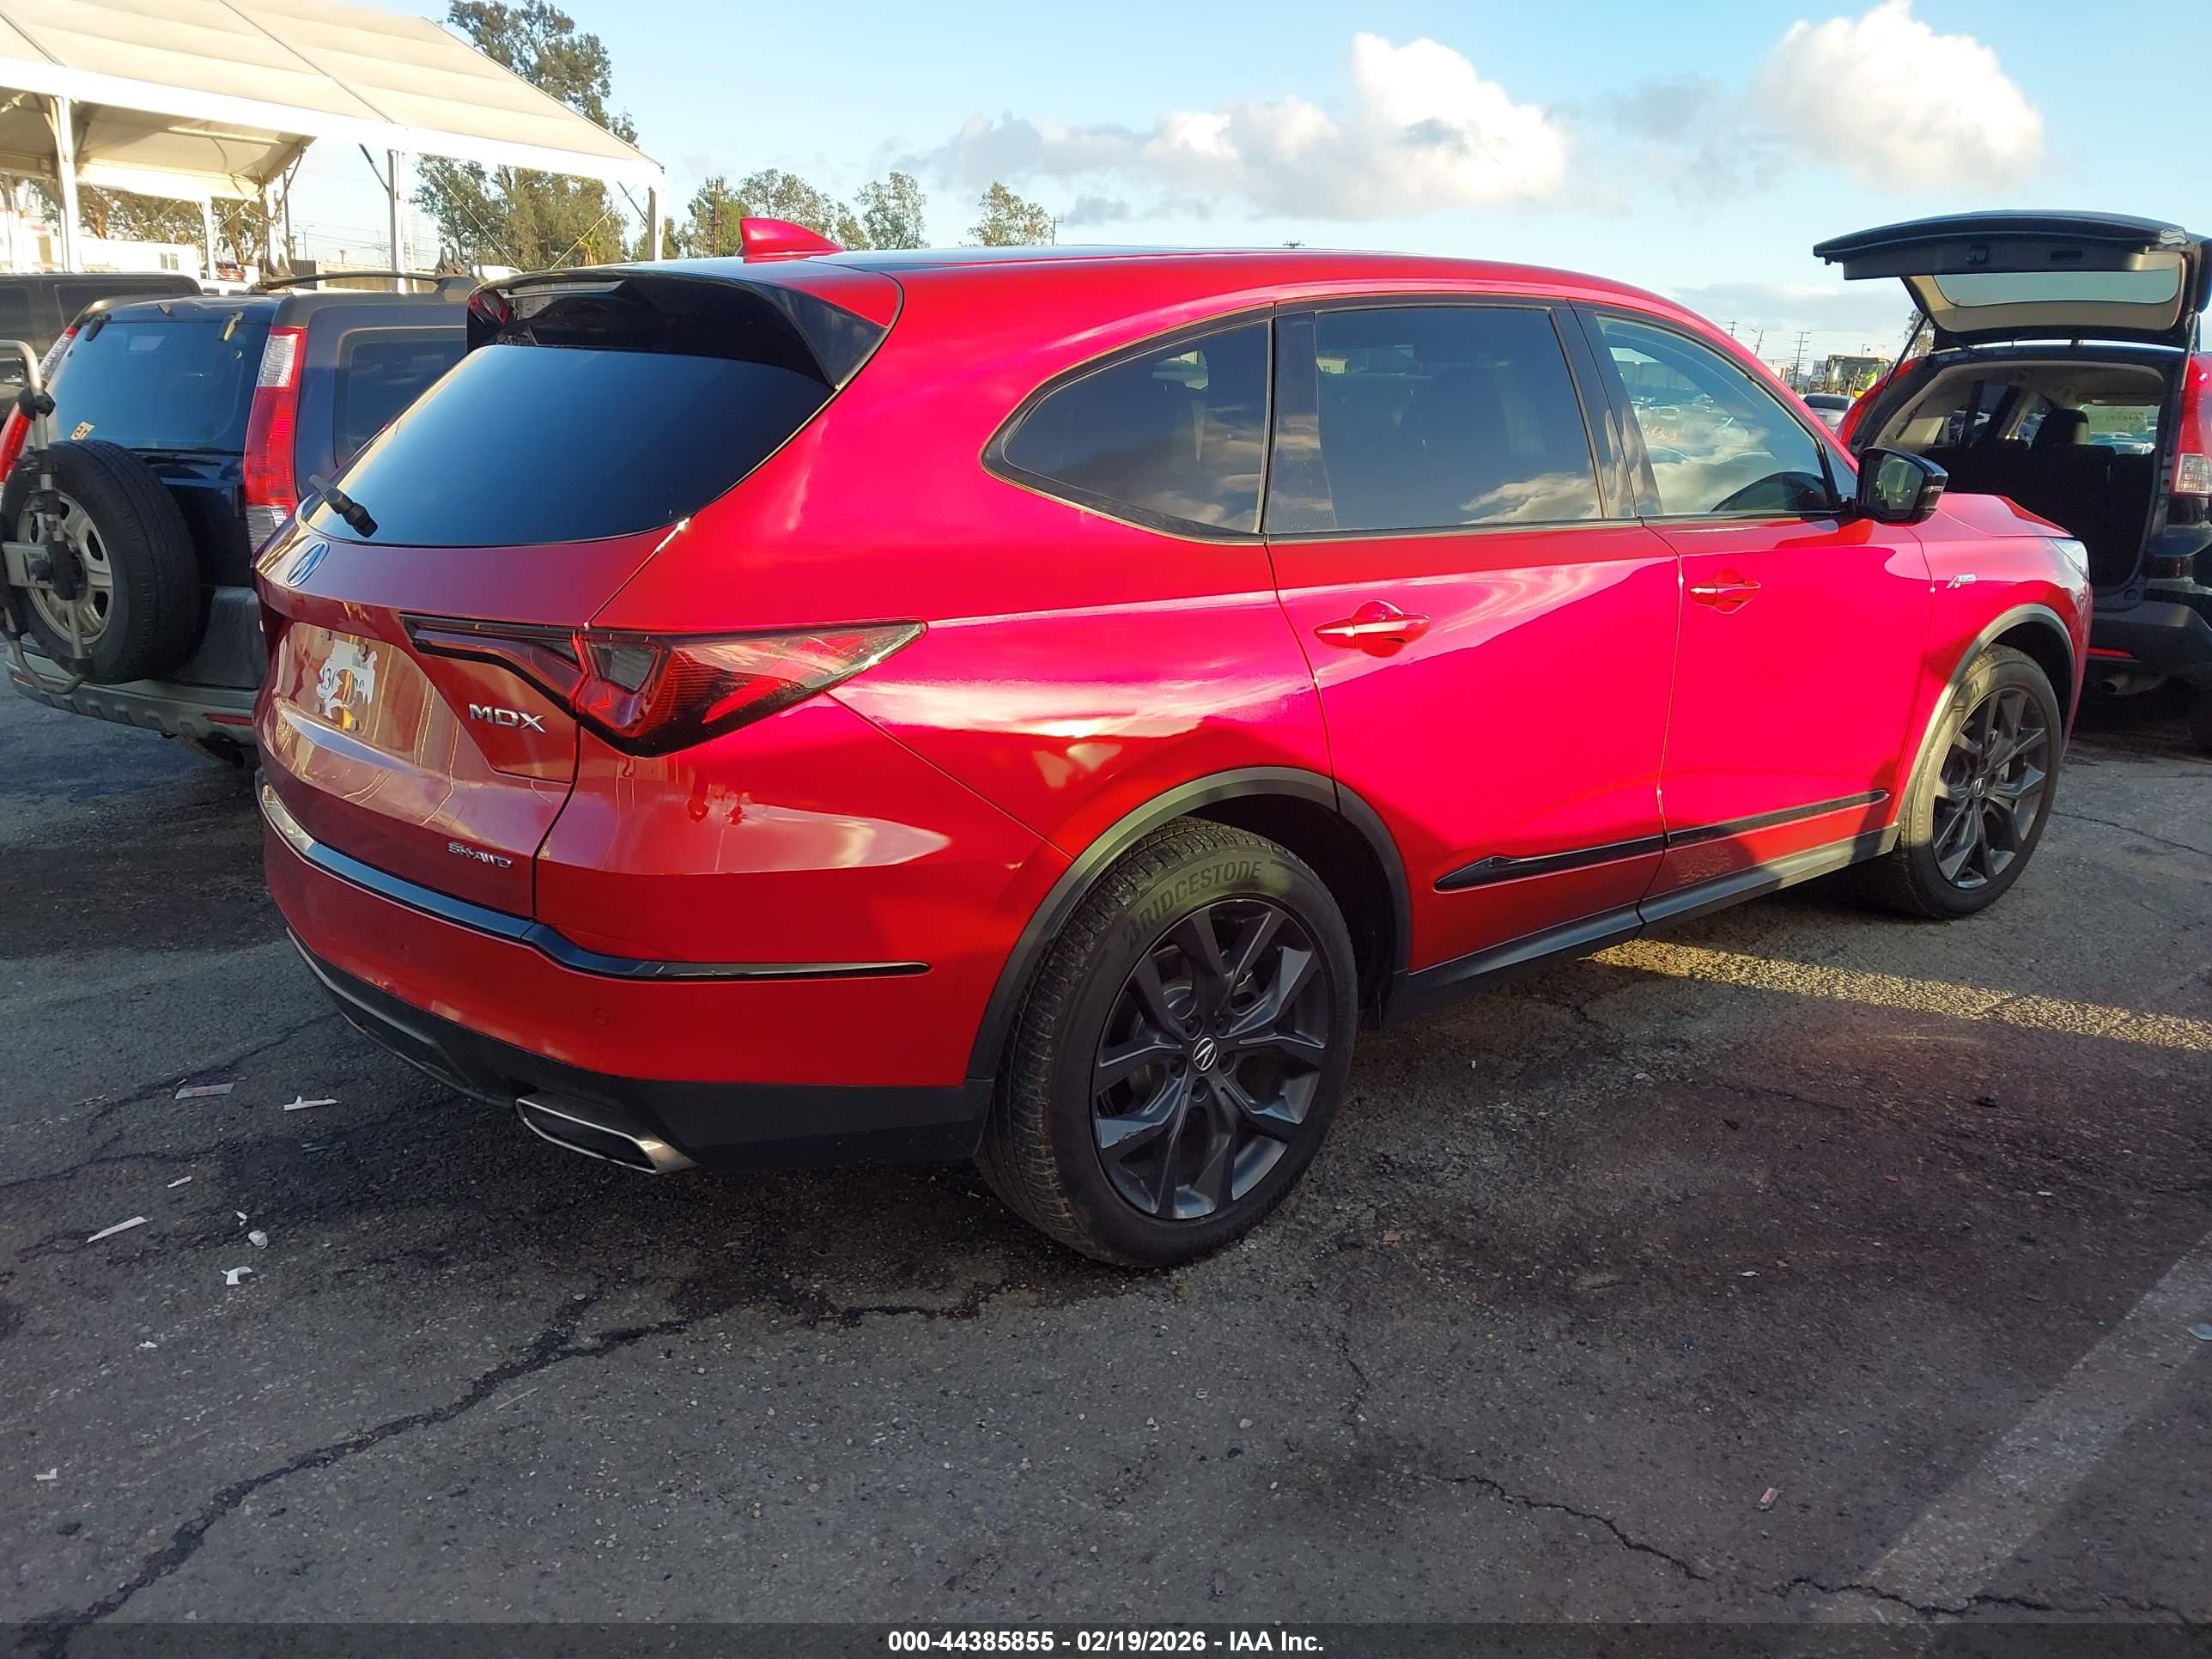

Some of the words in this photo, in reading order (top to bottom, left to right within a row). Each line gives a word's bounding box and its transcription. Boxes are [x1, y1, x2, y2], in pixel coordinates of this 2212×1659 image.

[469, 703, 546, 733] MDX
[447, 841, 514, 869] SH-AWD
[1121, 860, 1263, 951] BRIDGESTONE
